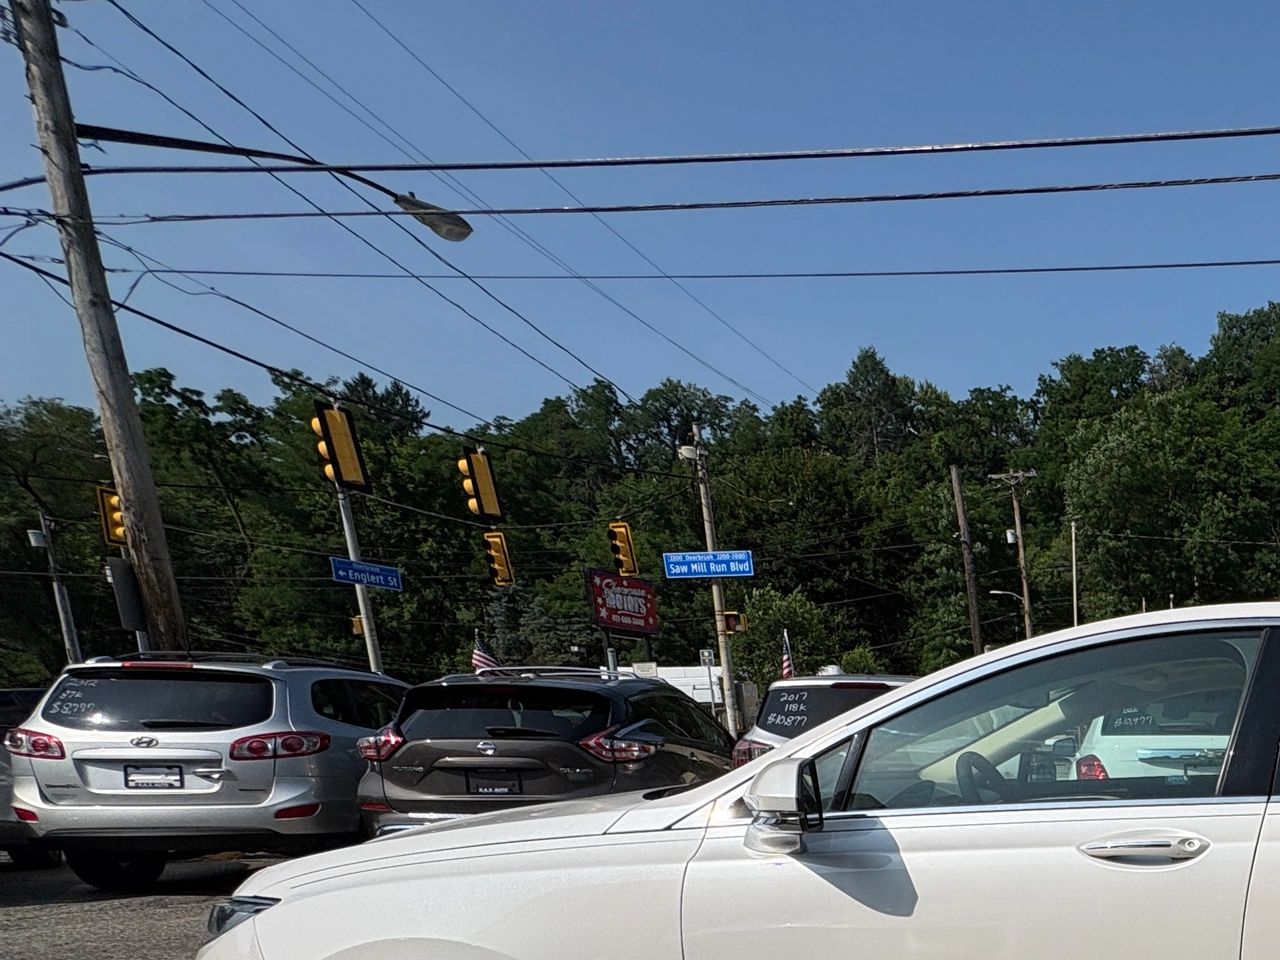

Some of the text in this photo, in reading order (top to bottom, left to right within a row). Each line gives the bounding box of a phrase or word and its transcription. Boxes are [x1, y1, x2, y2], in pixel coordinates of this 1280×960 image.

[669, 560, 750, 574] Saw Mill Run Blvd
[348, 569, 399, 588] Englert St
[780, 691, 808, 702] 2017
